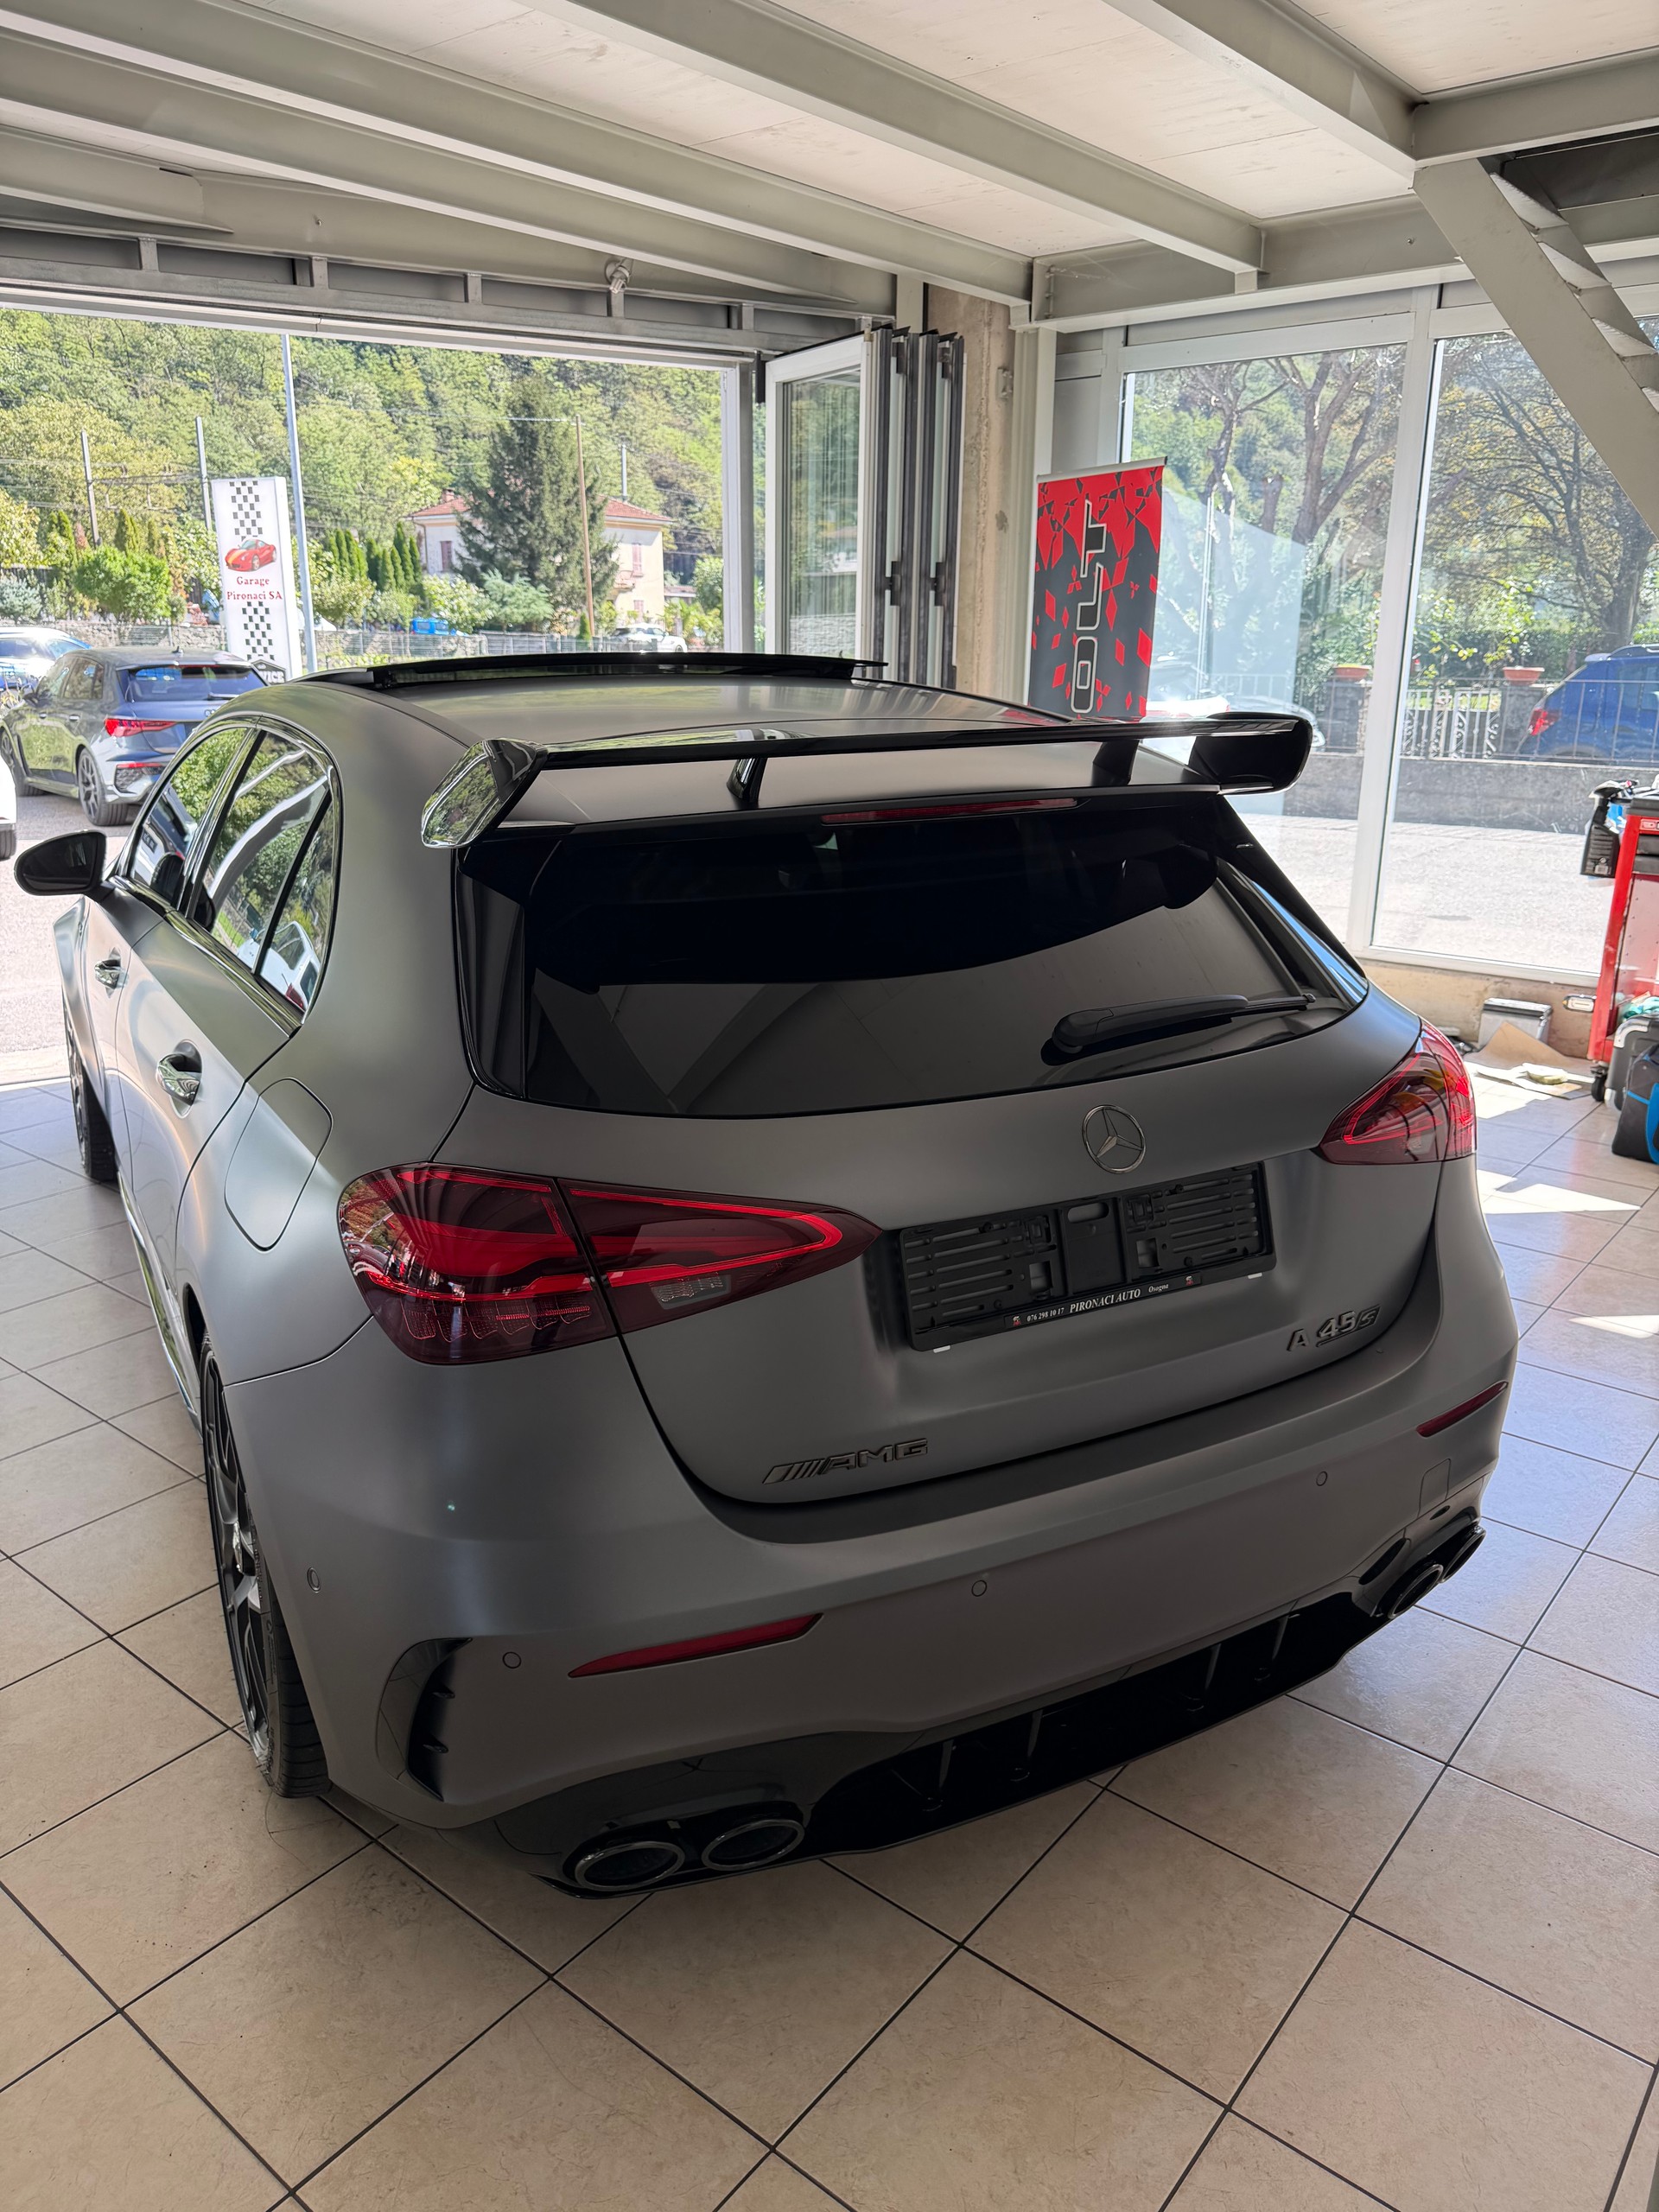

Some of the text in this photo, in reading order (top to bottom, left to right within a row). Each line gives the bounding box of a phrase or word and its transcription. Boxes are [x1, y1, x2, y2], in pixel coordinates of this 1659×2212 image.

[236, 575, 270, 587] Garage
[226, 590, 283, 600] Pironaci SA
[259, 671, 285, 683] VICE
[1039, 1311, 1049, 1319] 298
[1069, 1294, 1116, 1313] PIRONACI
[1116, 1288, 1141, 1302] AUTO
[1148, 1283, 1169, 1294] Osogna
[1287, 1328, 1310, 1351] A
[820, 1438, 929, 1476] AMG
